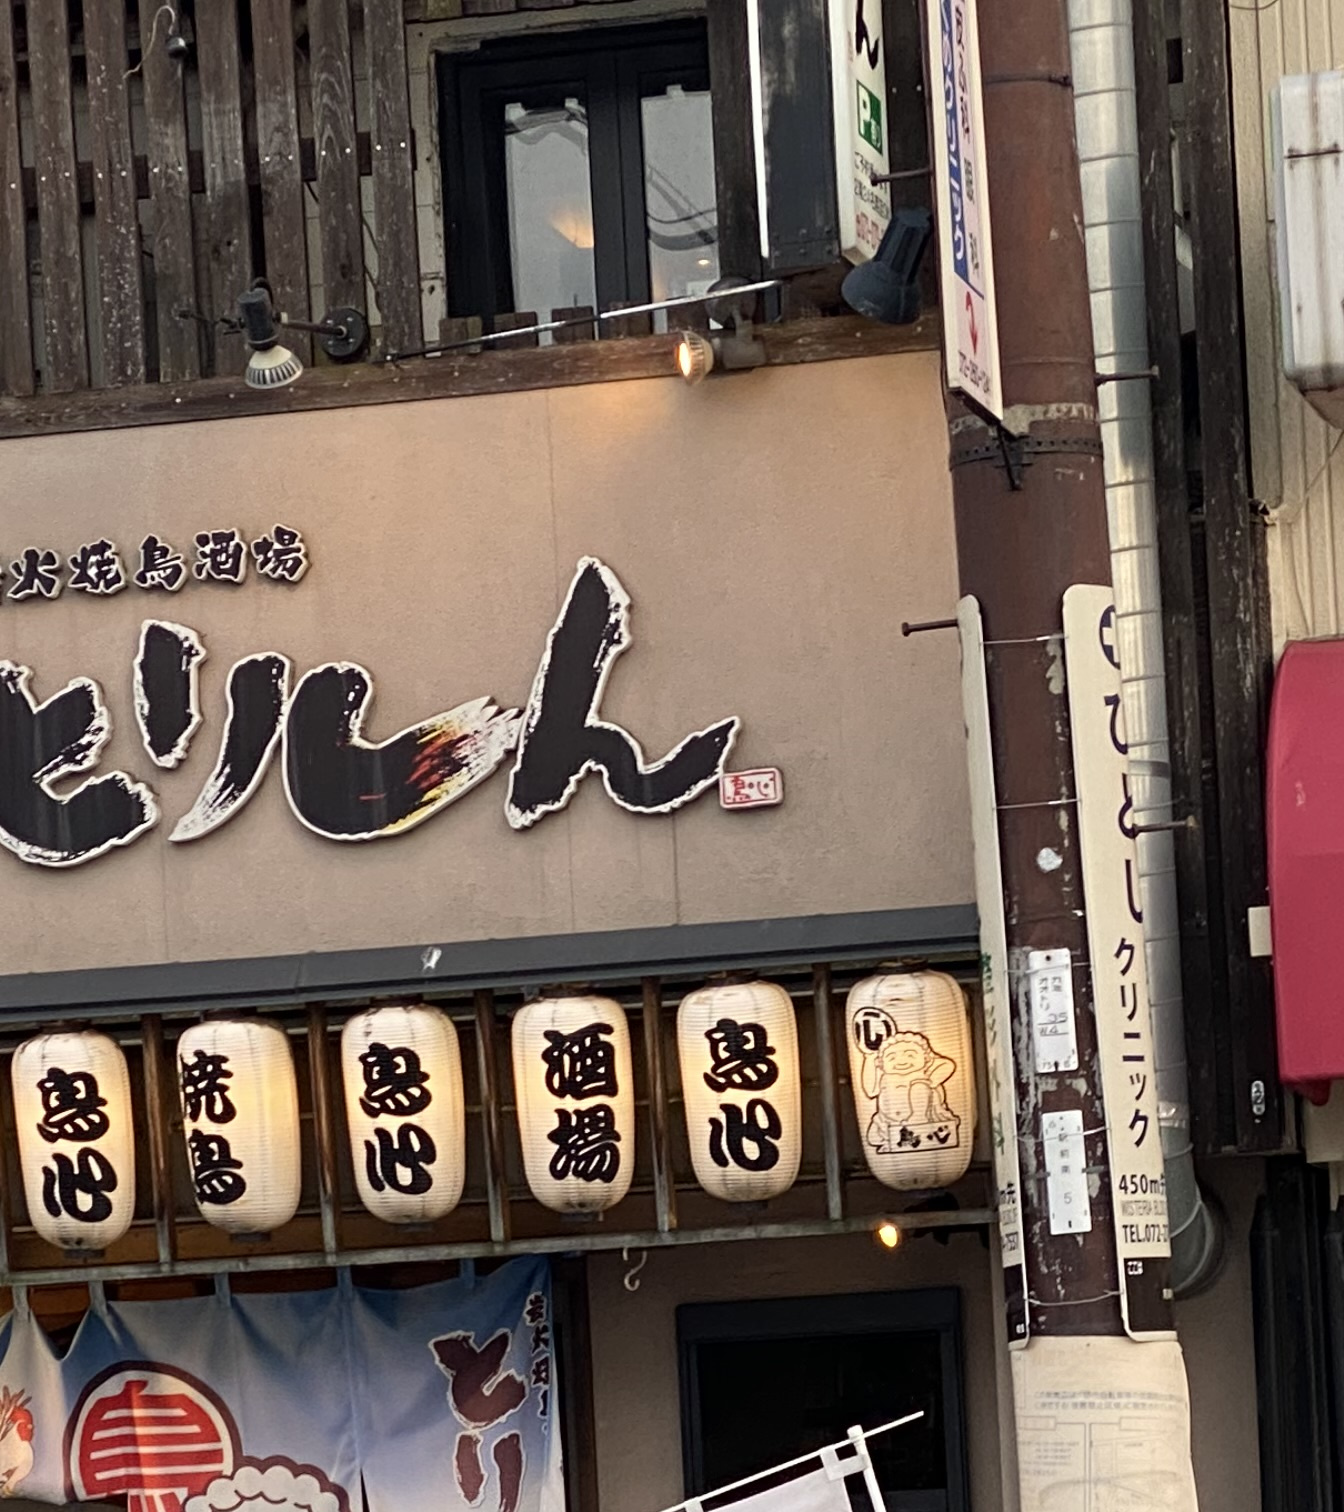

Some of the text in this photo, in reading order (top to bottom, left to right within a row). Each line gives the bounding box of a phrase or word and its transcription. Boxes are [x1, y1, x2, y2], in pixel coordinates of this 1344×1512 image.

[36, 1066, 117, 1223] 鳥心
[358, 1041, 436, 1195] 鳥心
[542, 1022, 623, 1184] 酒場
[703, 1017, 782, 1172] 鳥心
